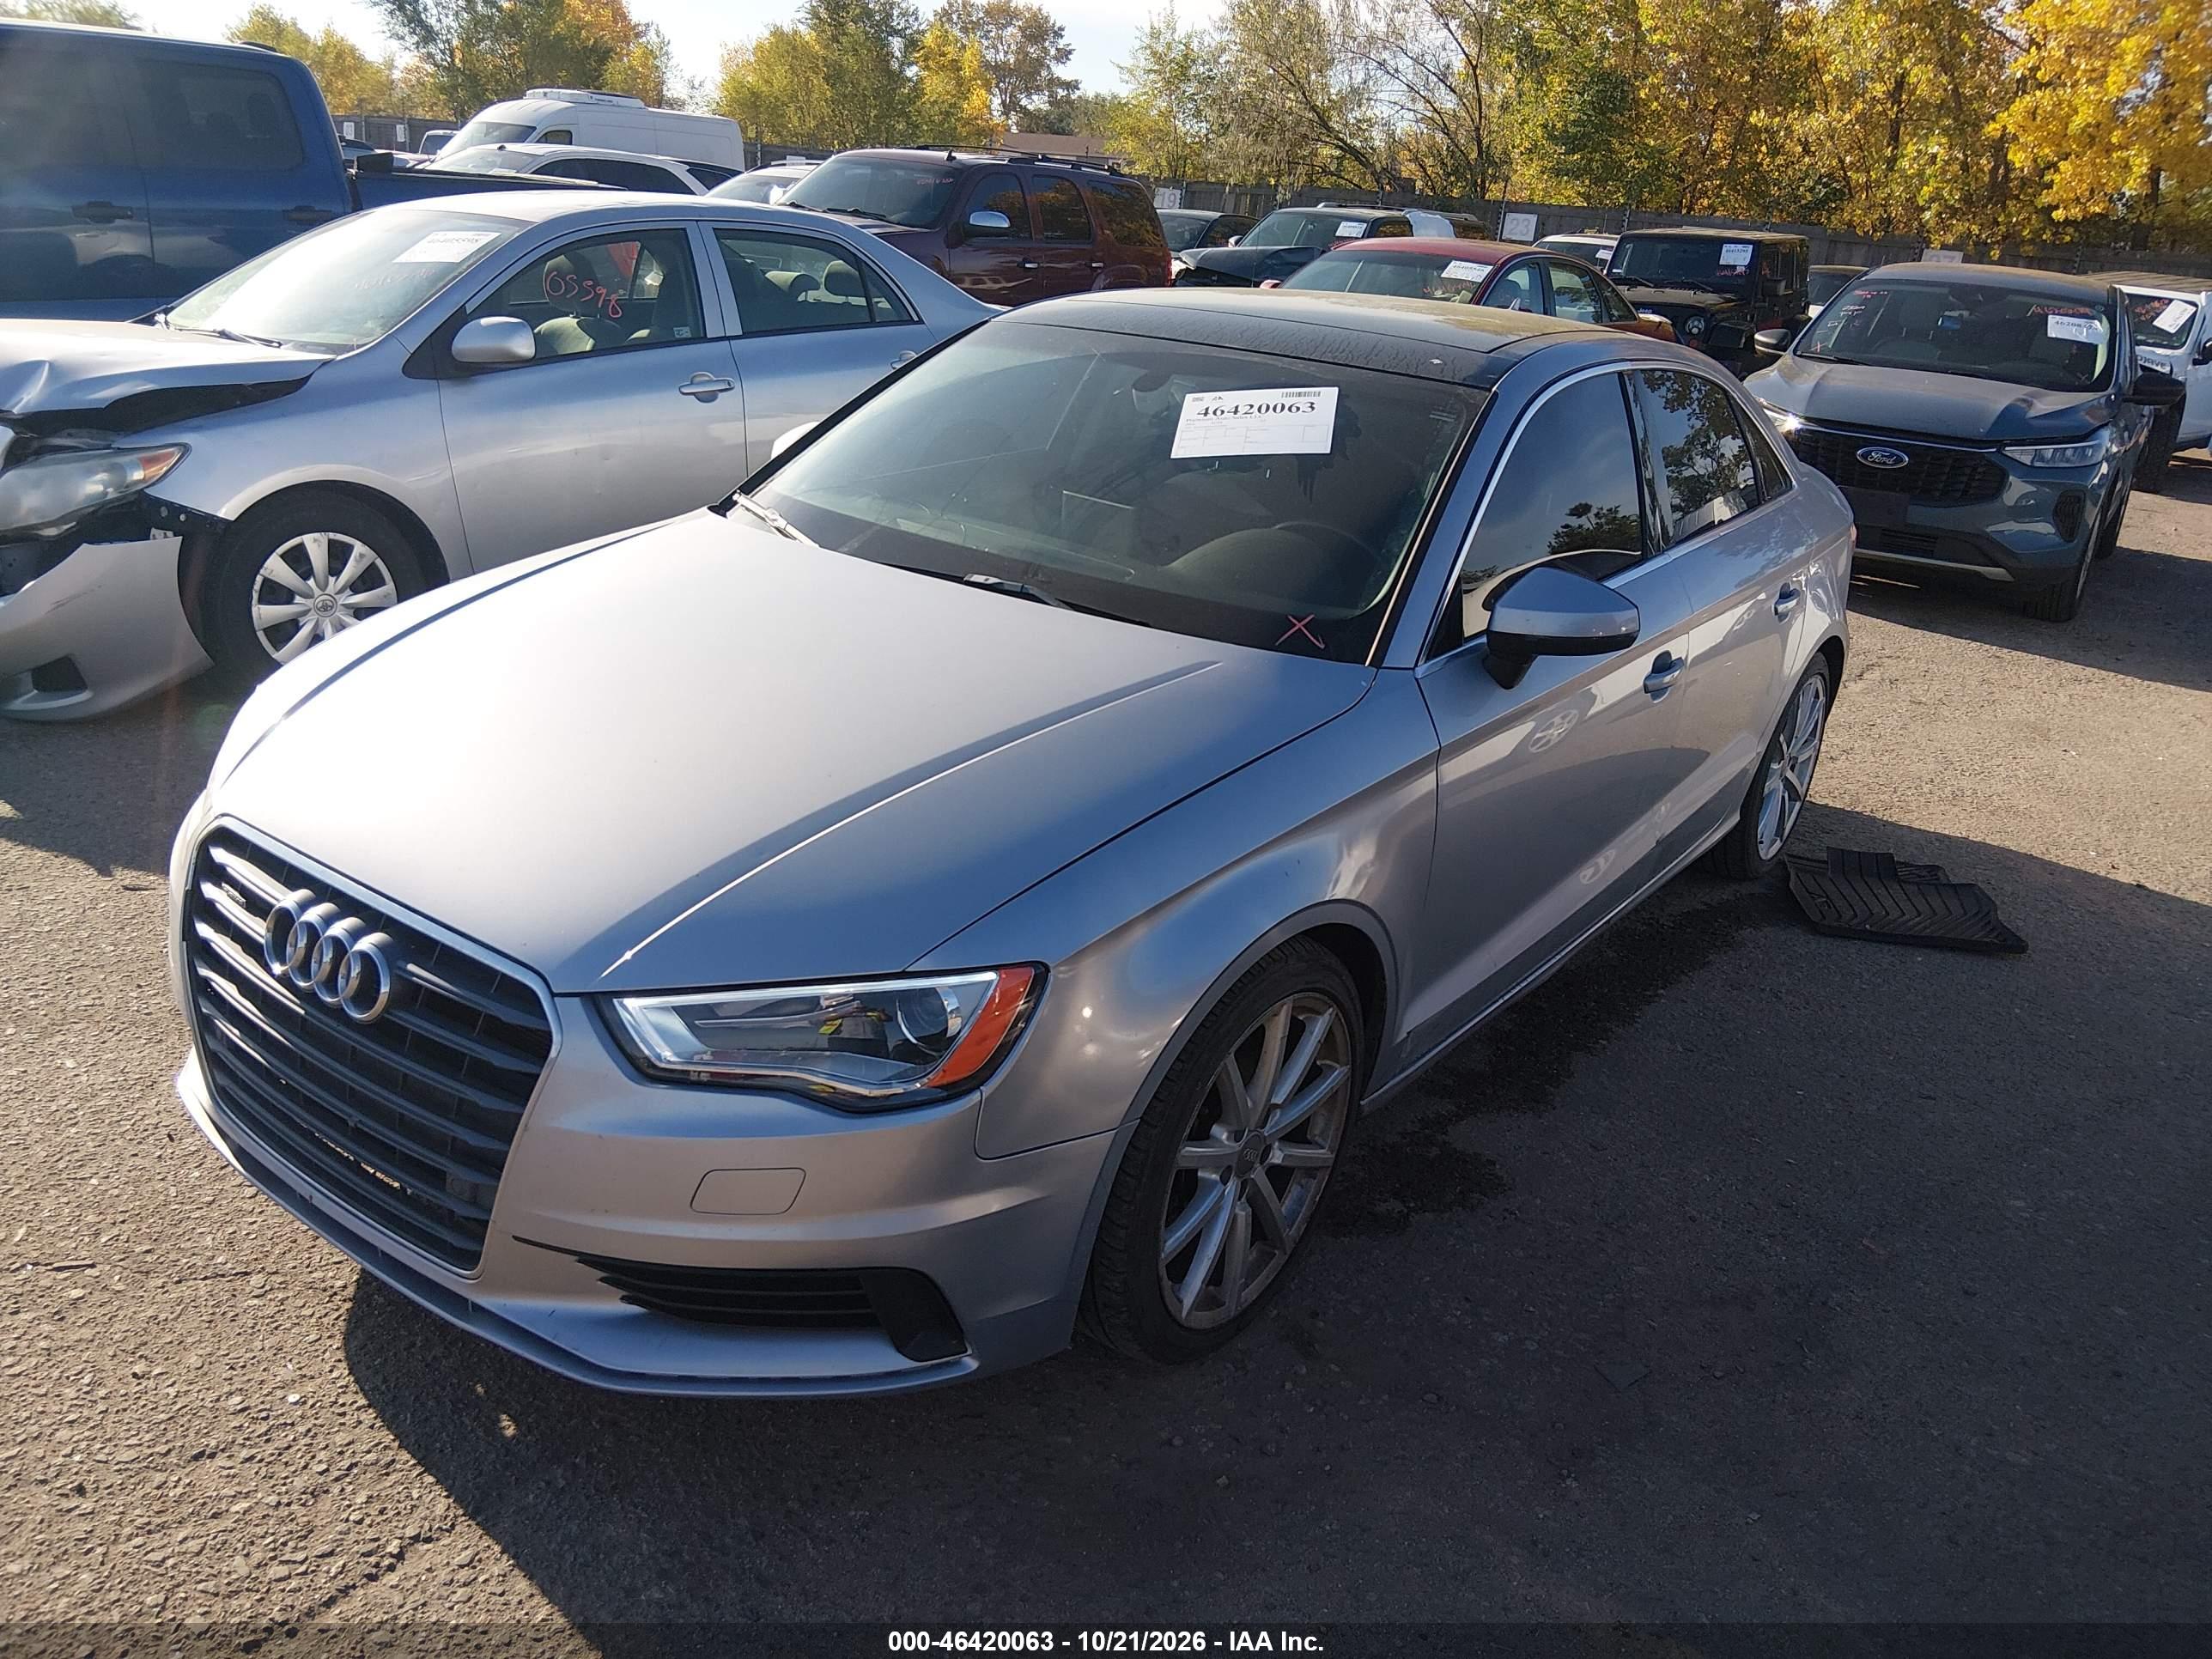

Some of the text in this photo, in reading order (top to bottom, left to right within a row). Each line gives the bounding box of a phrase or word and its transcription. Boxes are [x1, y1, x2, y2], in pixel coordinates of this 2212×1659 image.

[1161, 191, 1177, 208] 19
[1509, 217, 1530, 236] 23
[1197, 401, 1316, 418] 46420063
[1867, 450, 1897, 465] Ford
